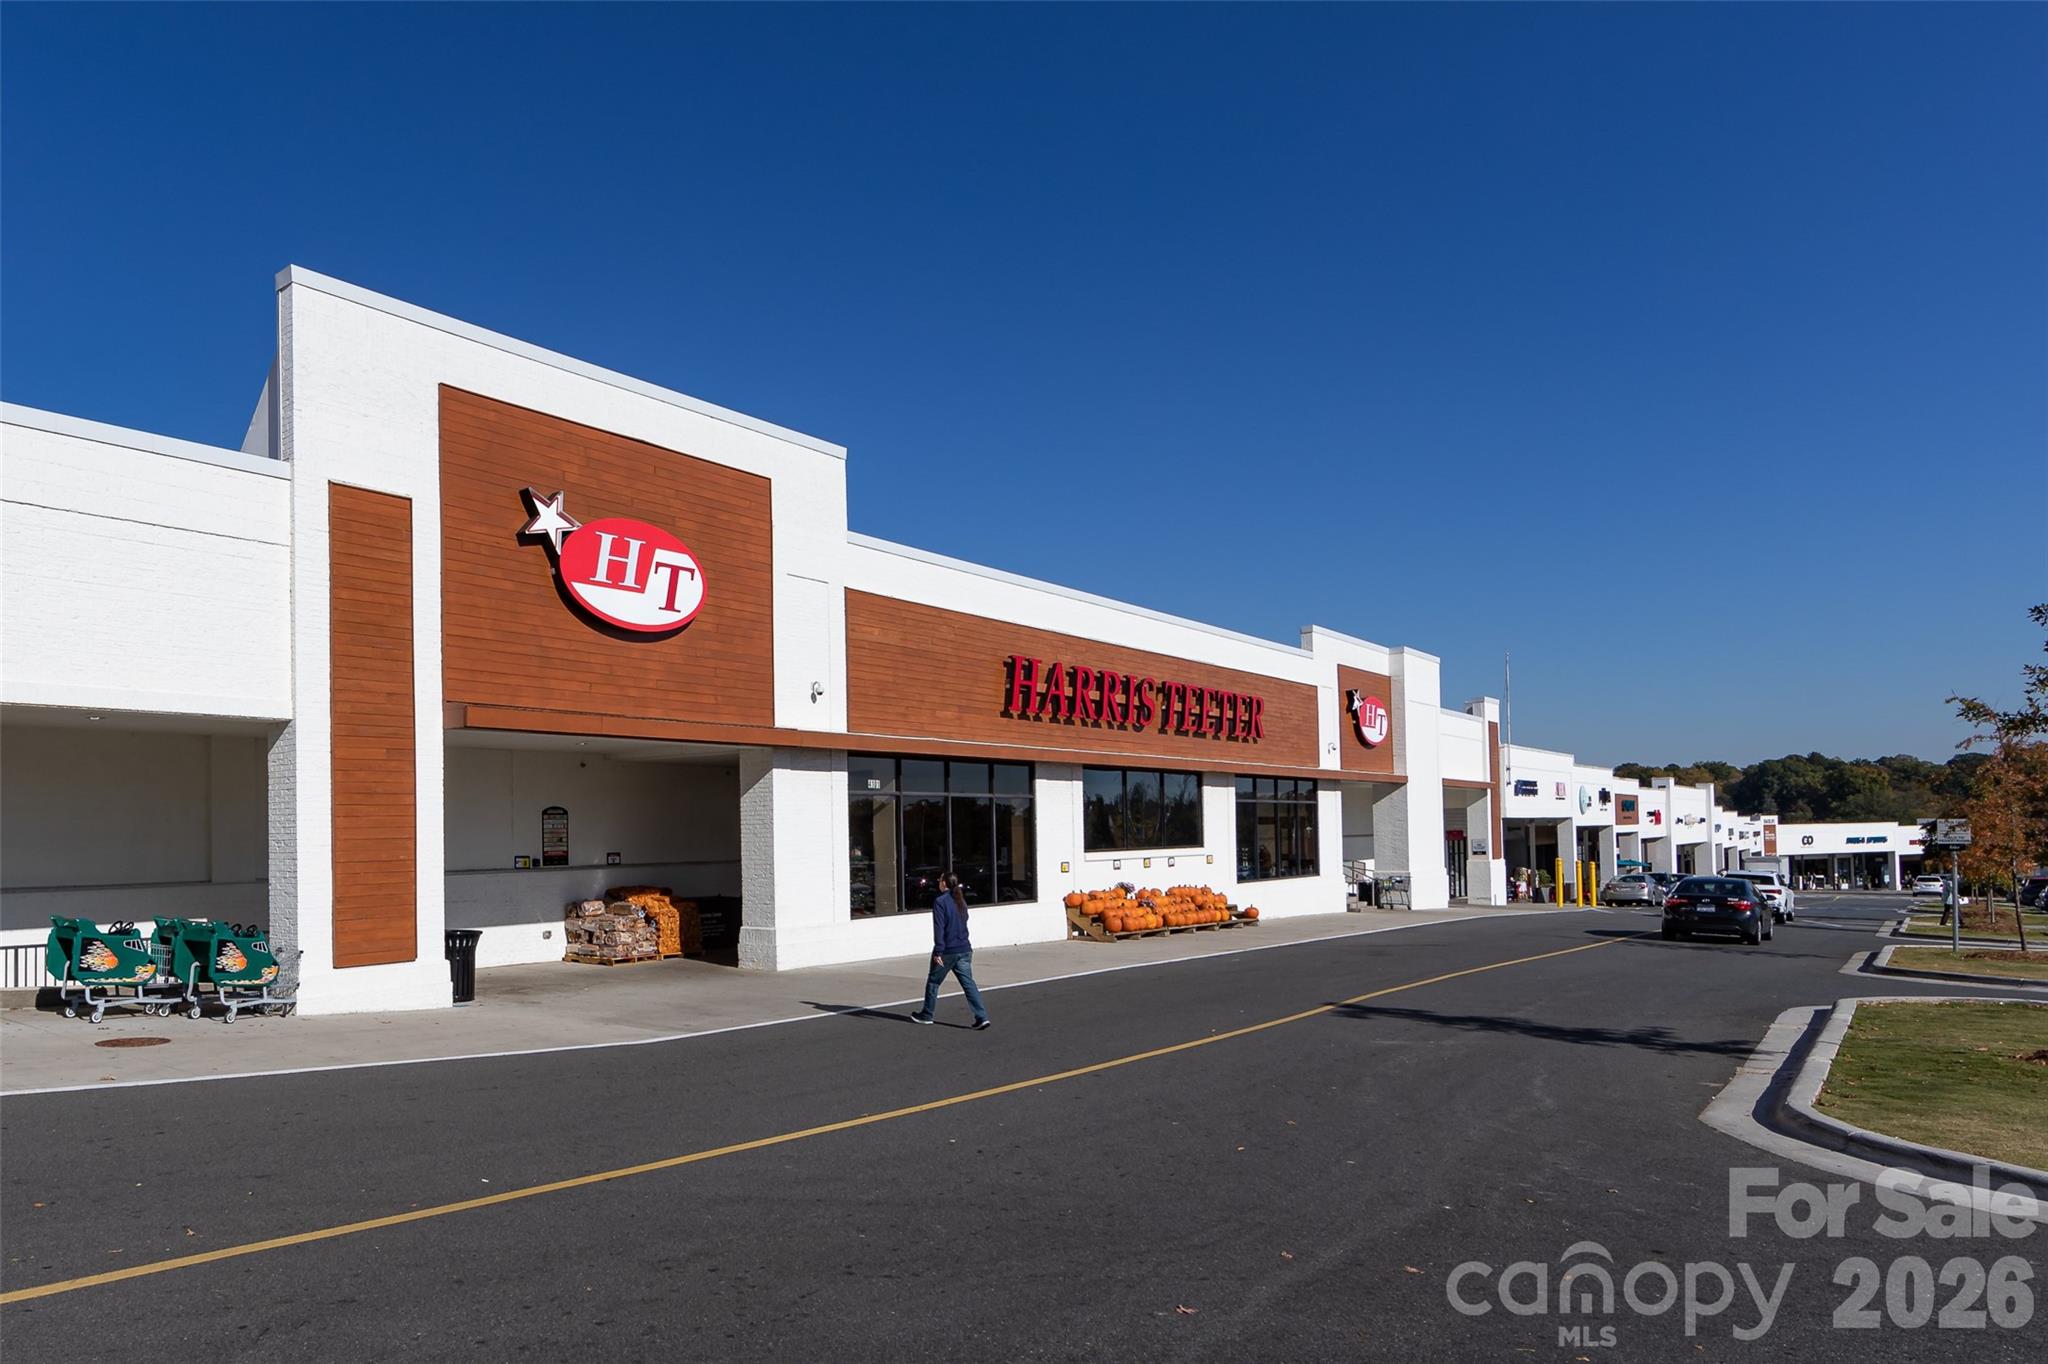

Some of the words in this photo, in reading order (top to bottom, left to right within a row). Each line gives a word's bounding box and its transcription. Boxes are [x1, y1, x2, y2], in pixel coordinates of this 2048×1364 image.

[590, 531, 695, 613] HT
[1006, 655, 1156, 727] HARRIS
[1164, 680, 1265, 739] TEETER
